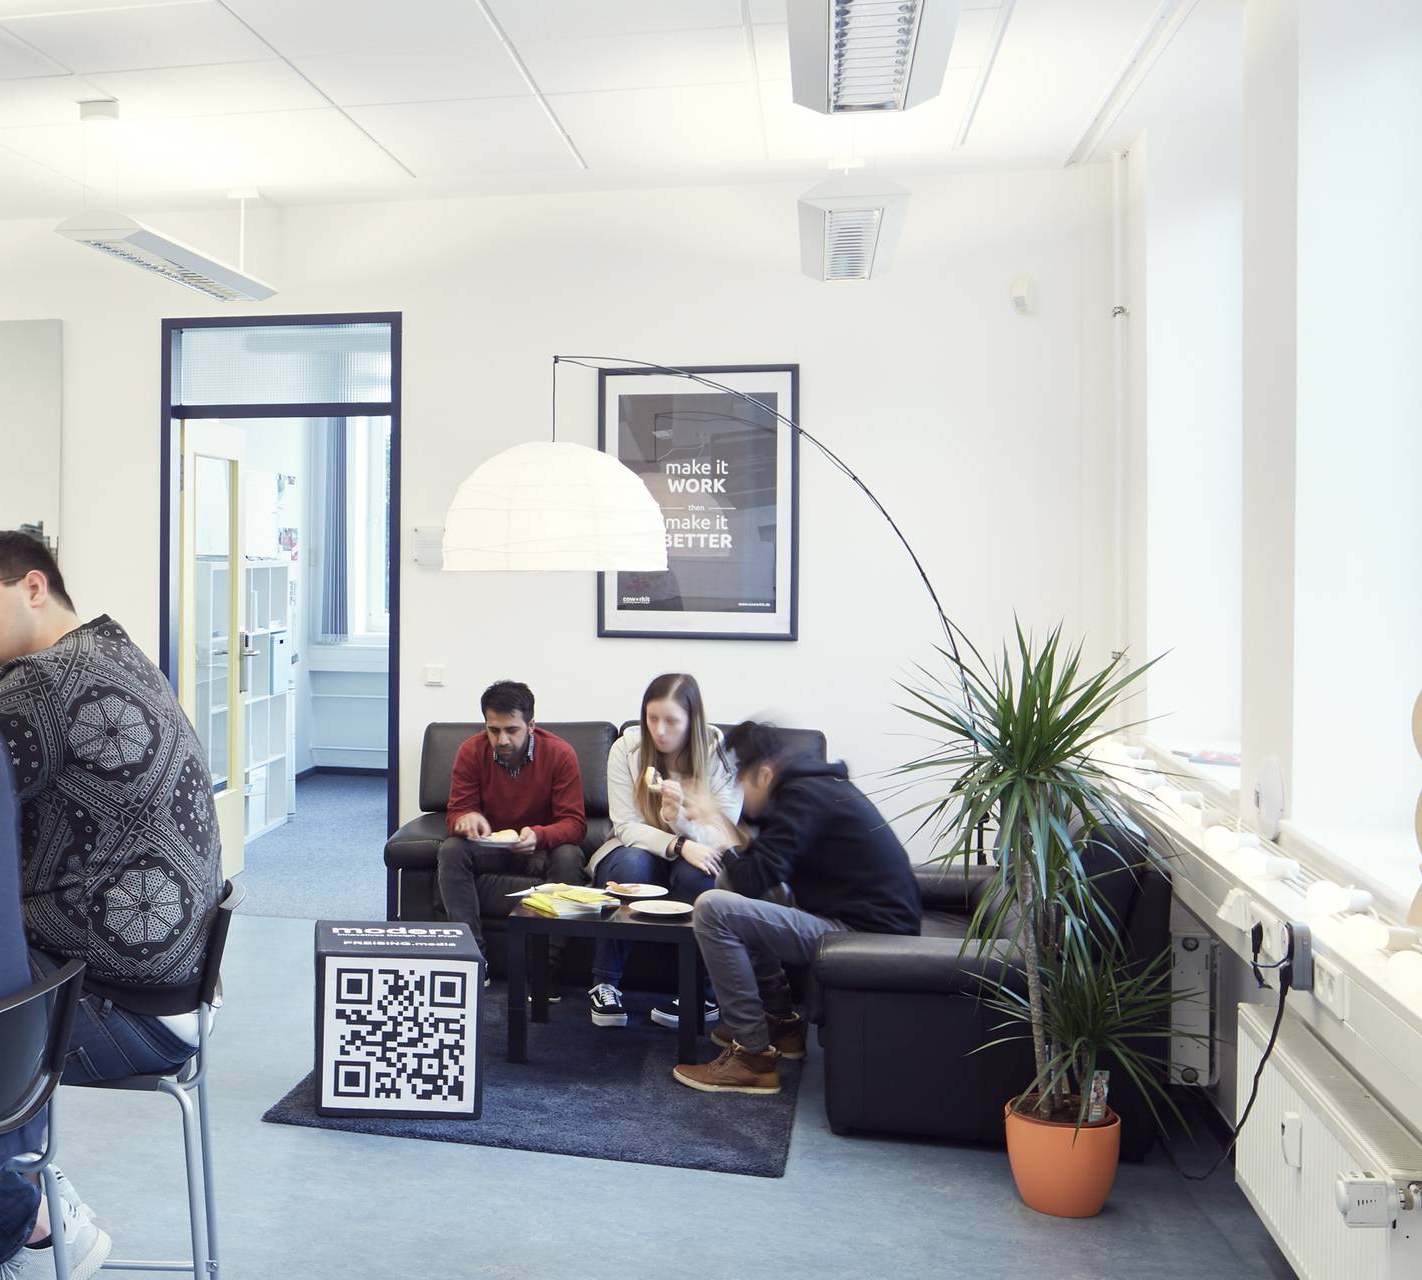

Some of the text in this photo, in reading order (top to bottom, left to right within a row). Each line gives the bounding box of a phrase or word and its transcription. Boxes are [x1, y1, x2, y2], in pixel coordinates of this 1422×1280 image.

[666, 459, 729, 475] make it
[667, 478, 727, 493] WORK
[665, 514, 729, 530] make it
[664, 533, 732, 548] BETTER
[332, 927, 464, 936] modern
